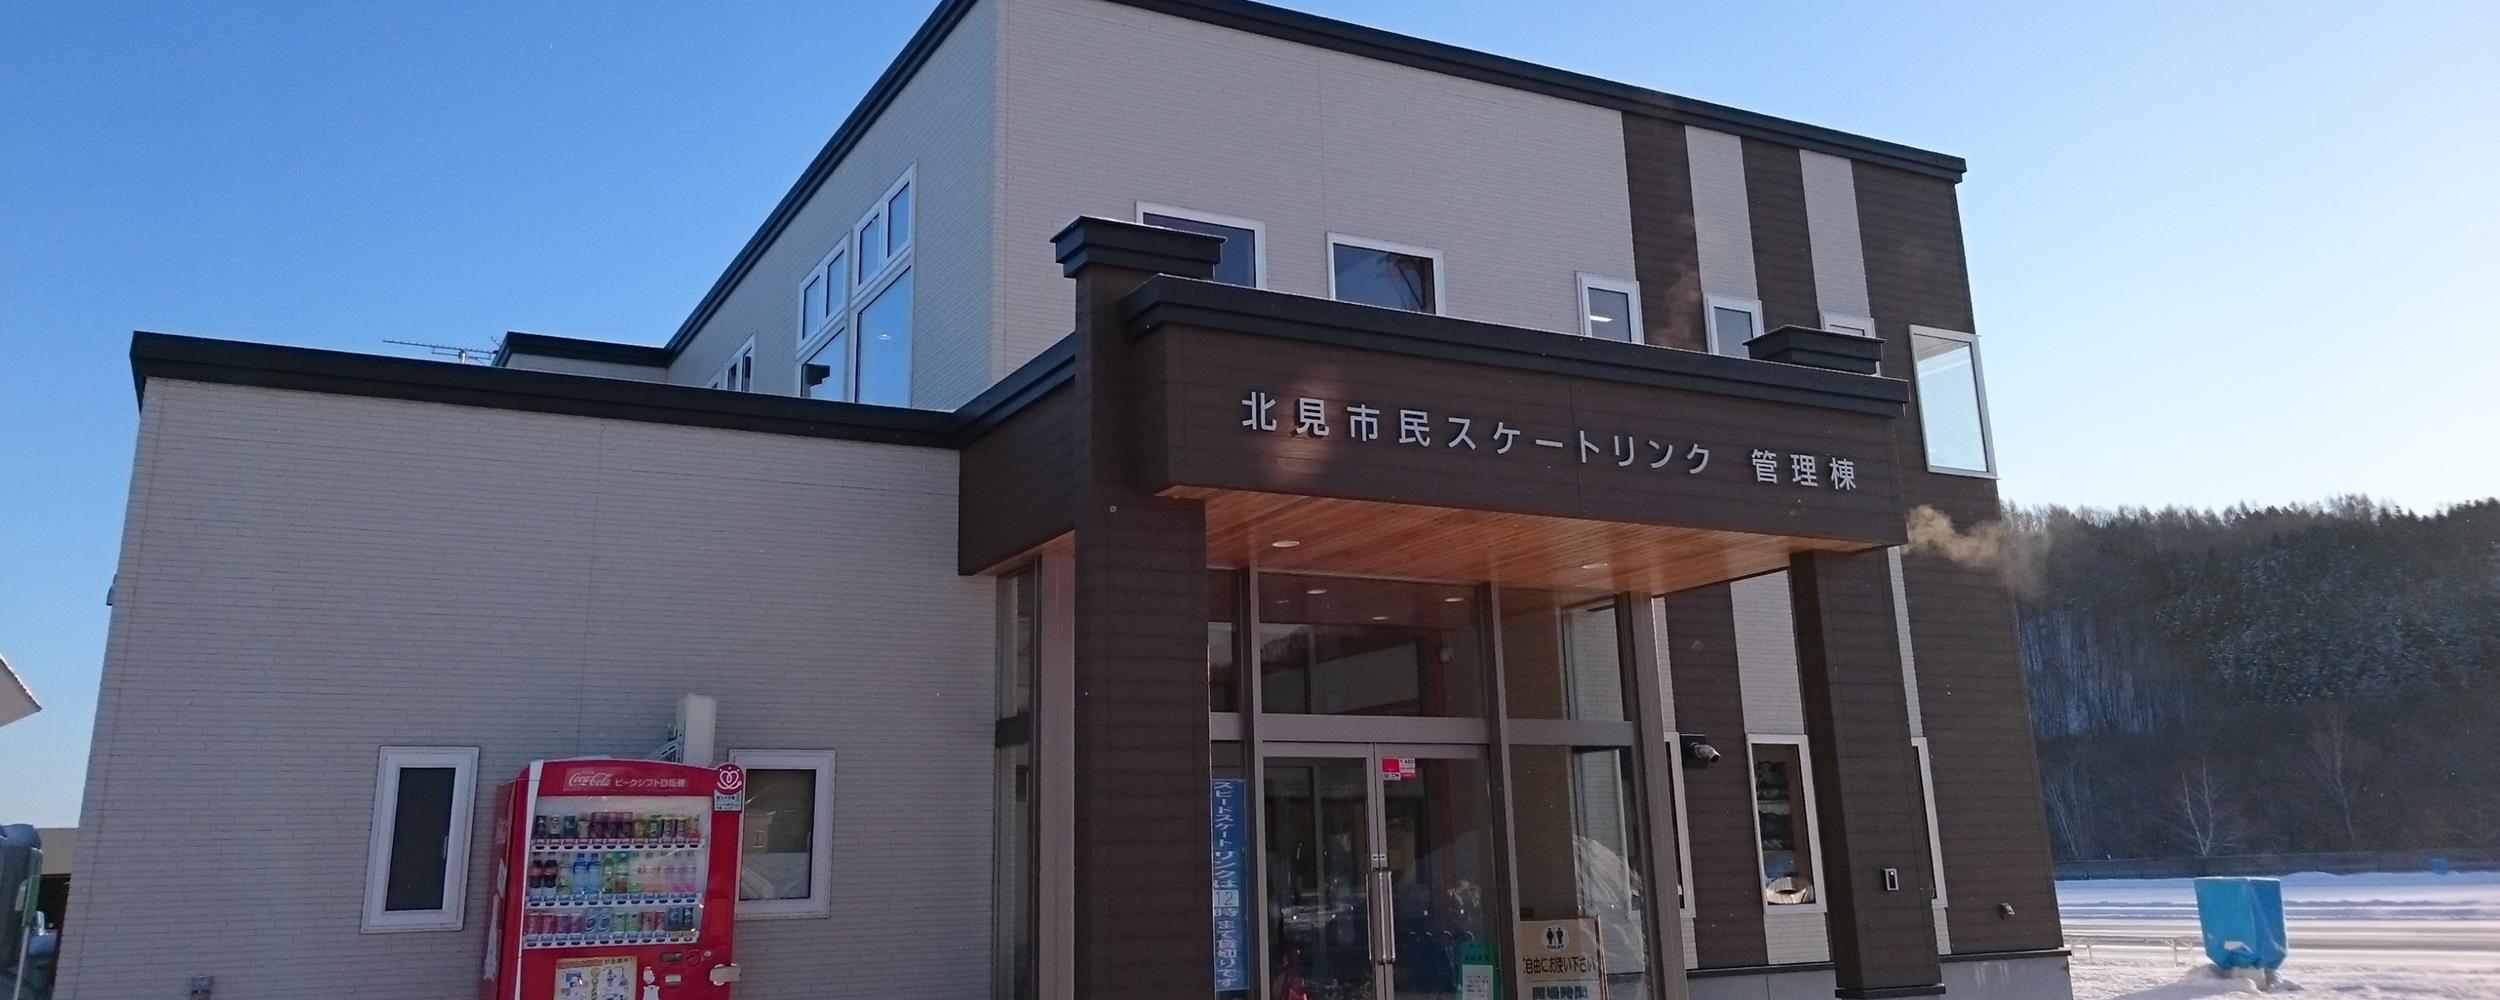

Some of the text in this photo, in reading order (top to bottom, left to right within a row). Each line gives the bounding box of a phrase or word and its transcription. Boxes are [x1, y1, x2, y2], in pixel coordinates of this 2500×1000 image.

[1241, 391, 1857, 491] 北見市民スケートリンク 管理棟
